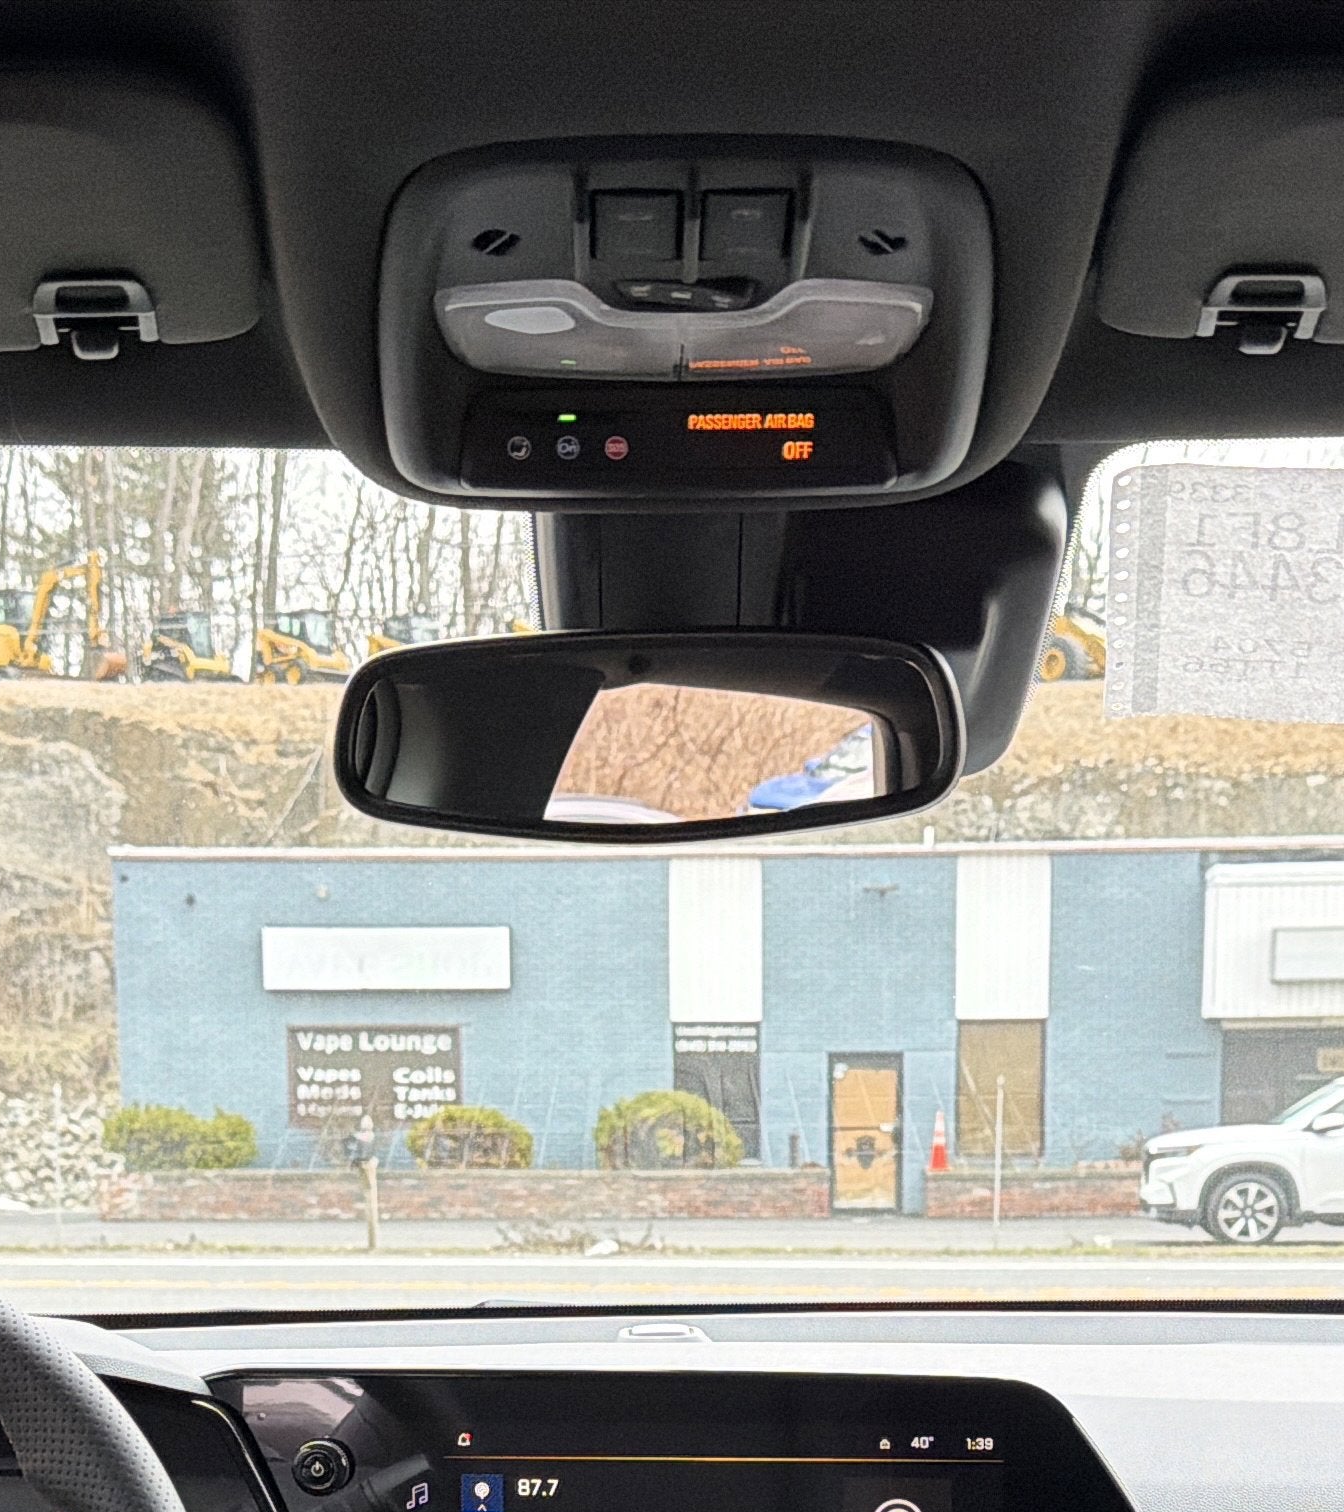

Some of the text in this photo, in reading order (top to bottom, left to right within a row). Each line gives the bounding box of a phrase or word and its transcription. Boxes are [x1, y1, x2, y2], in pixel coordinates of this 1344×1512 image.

[687, 414, 814, 430] PASSENGER AIR BAG
[783, 441, 813, 459] OFF
[296, 1031, 452, 1054] Vape Lounge
[297, 1066, 361, 1083] Vapes
[966, 1438, 994, 1450] 1:39
[518, 1479, 558, 1496] 87.7
